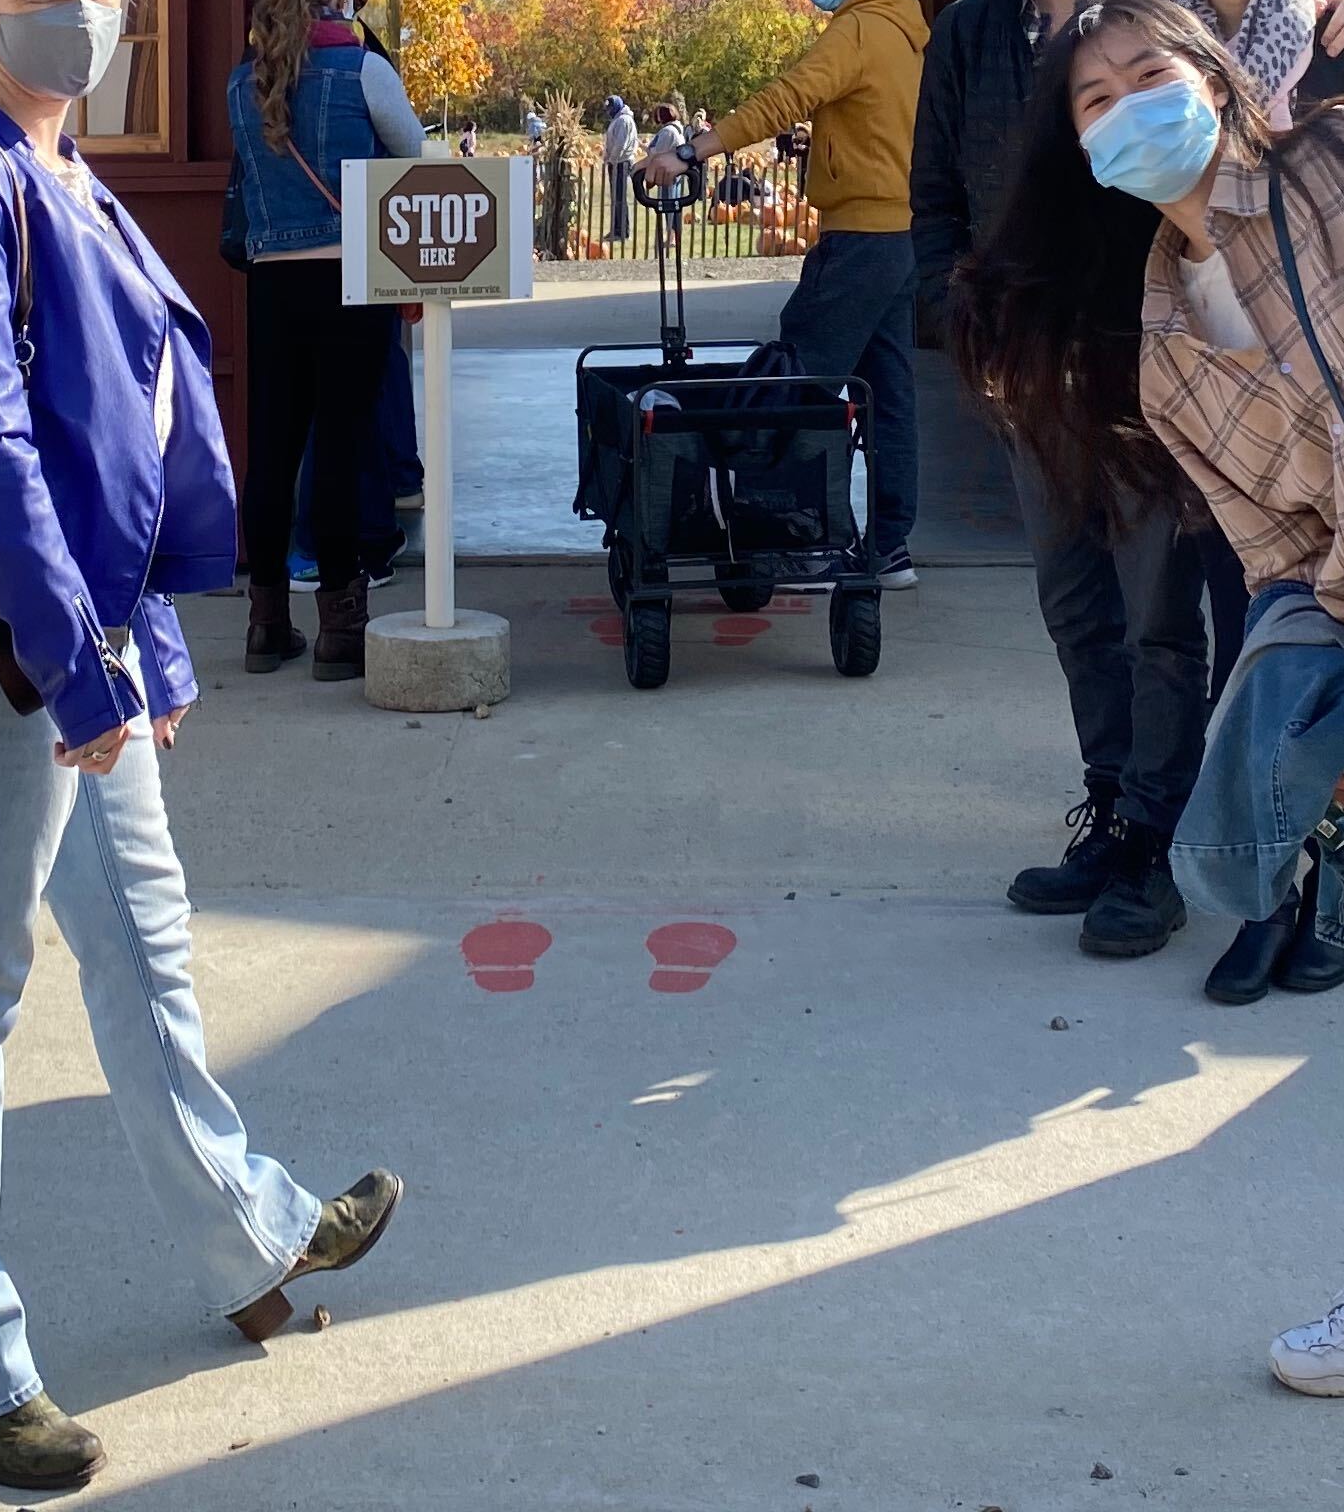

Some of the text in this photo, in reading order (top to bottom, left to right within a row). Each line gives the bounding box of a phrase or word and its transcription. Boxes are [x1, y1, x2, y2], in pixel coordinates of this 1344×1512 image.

[387, 194, 489, 245] STOP
[420, 248, 456, 266] HERE
[374, 287, 398, 296] Please
[420, 287, 437, 298] your
[459, 285, 470, 294] for
